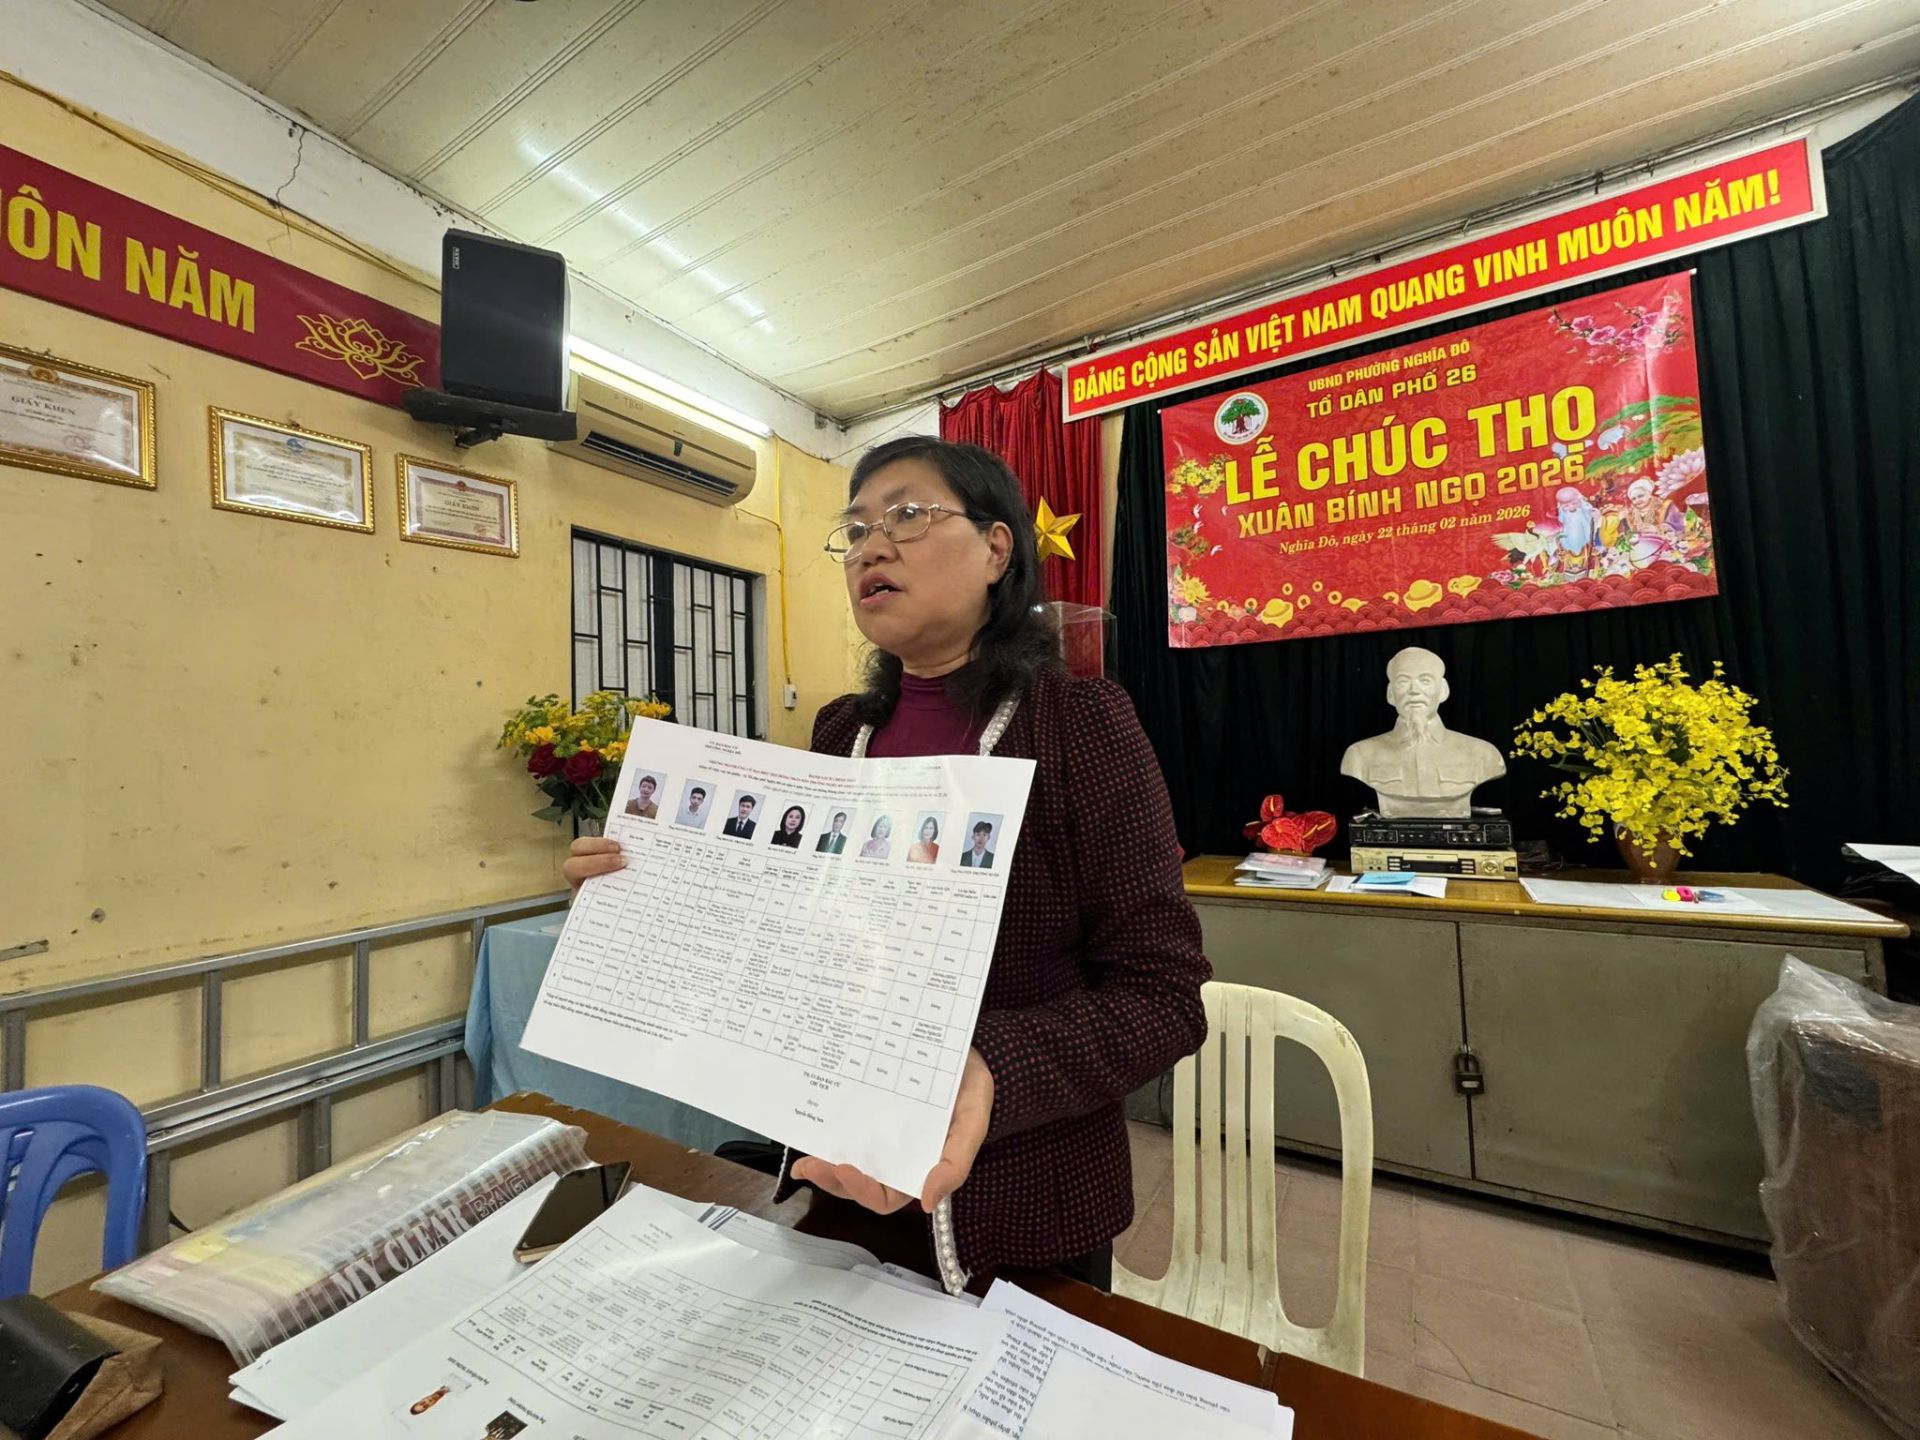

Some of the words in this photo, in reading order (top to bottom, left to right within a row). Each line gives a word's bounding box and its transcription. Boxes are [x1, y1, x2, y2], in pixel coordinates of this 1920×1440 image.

[0, 184, 101, 281] ÔN
[126, 244, 255, 334] NĂM
[1073, 366, 1125, 404] ĐẢNG
[1131, 347, 1187, 388] CỘNG
[1193, 328, 1240, 369] SẢN
[1245, 313, 1295, 353] VIỆT
[1302, 294, 1362, 338] NAM
[1370, 264, 1465, 320] QUANG
[1473, 238, 1548, 288] VINH
[1557, 206, 1663, 266] MUÔN
[1673, 168, 1781, 233] NĂM!
[1306, 393, 1333, 419] TỔ
[1339, 388, 1384, 412] DÂN
[1392, 368, 1438, 399] PHỐ
[1446, 364, 1477, 386] 26
[1308, 374, 1343, 392] UBND
[1346, 359, 1400, 384] PHƯỜNG
[1403, 347, 1447, 370] NGHĨA
[1450, 339, 1471, 357] ĐÔ
[1225, 434, 1280, 506] LỄ
[1297, 415, 1449, 491] CHÚC
[1467, 385, 1598, 456] THỌ
[1237, 501, 1315, 539] XUÂN
[1327, 486, 1402, 524] BÍNH
[1414, 471, 1487, 508] NGỌ
[1497, 455, 1586, 495] 2026
[1279, 541, 1315, 555] Nghĩa
[1318, 536, 1340, 550] Đô,
[1342, 530, 1374, 545] ngày
[1377, 526, 1393, 538] 22
[1396, 521, 1436, 537] tháng
[1439, 518, 1456, 530] 02
[1460, 512, 1492, 527] năm
[1496, 505, 1530, 520] 2026
[329, 1253, 385, 1306] MY
[384, 1204, 473, 1273] CLEAR
[467, 1173, 528, 1222] BAG
